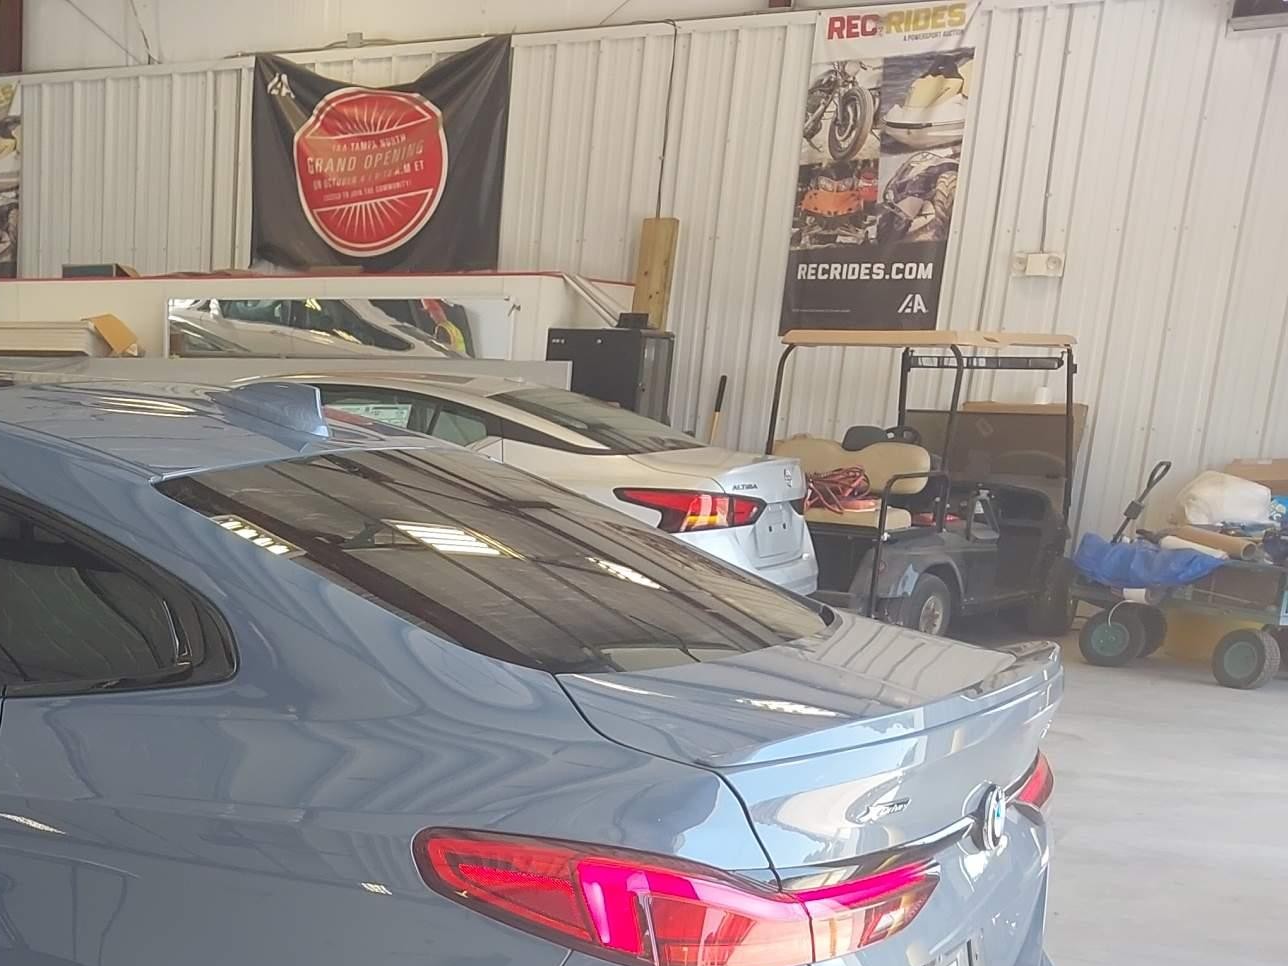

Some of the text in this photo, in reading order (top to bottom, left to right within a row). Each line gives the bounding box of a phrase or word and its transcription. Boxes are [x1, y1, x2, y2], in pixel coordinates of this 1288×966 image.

[886, 2, 967, 34] RIDES
[307, 156, 357, 175] GRAND
[363, 139, 425, 169] OPENING
[414, 159, 425, 172] ET
[797, 262, 933, 280] RECRIDES.COM
